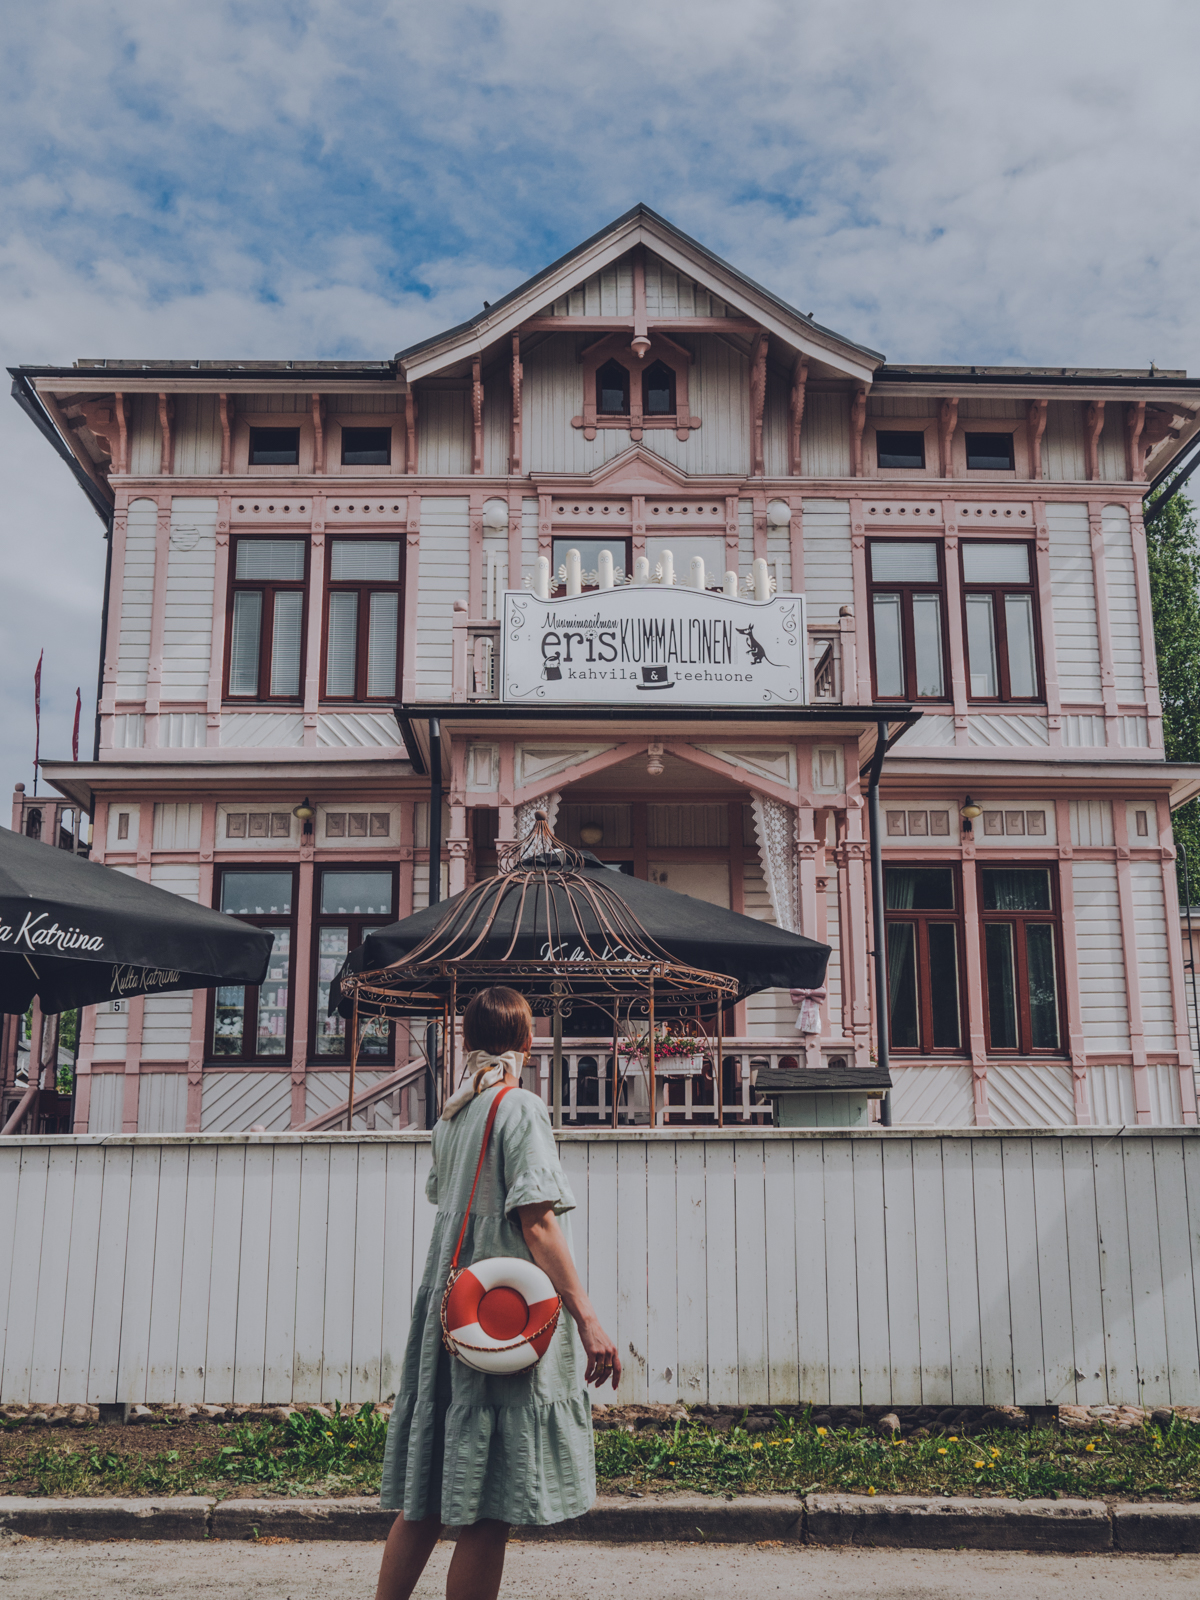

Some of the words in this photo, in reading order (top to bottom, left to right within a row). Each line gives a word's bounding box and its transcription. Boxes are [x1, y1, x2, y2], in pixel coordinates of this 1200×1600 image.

[568, 668, 638, 680] kahvila
[650, 671, 659, 680] &
[674, 670, 753, 682] teehuone
[13, 911, 104, 951] Katriina
[110, 963, 139, 995] Kulta
[114, 1001, 120, 1012] 5
